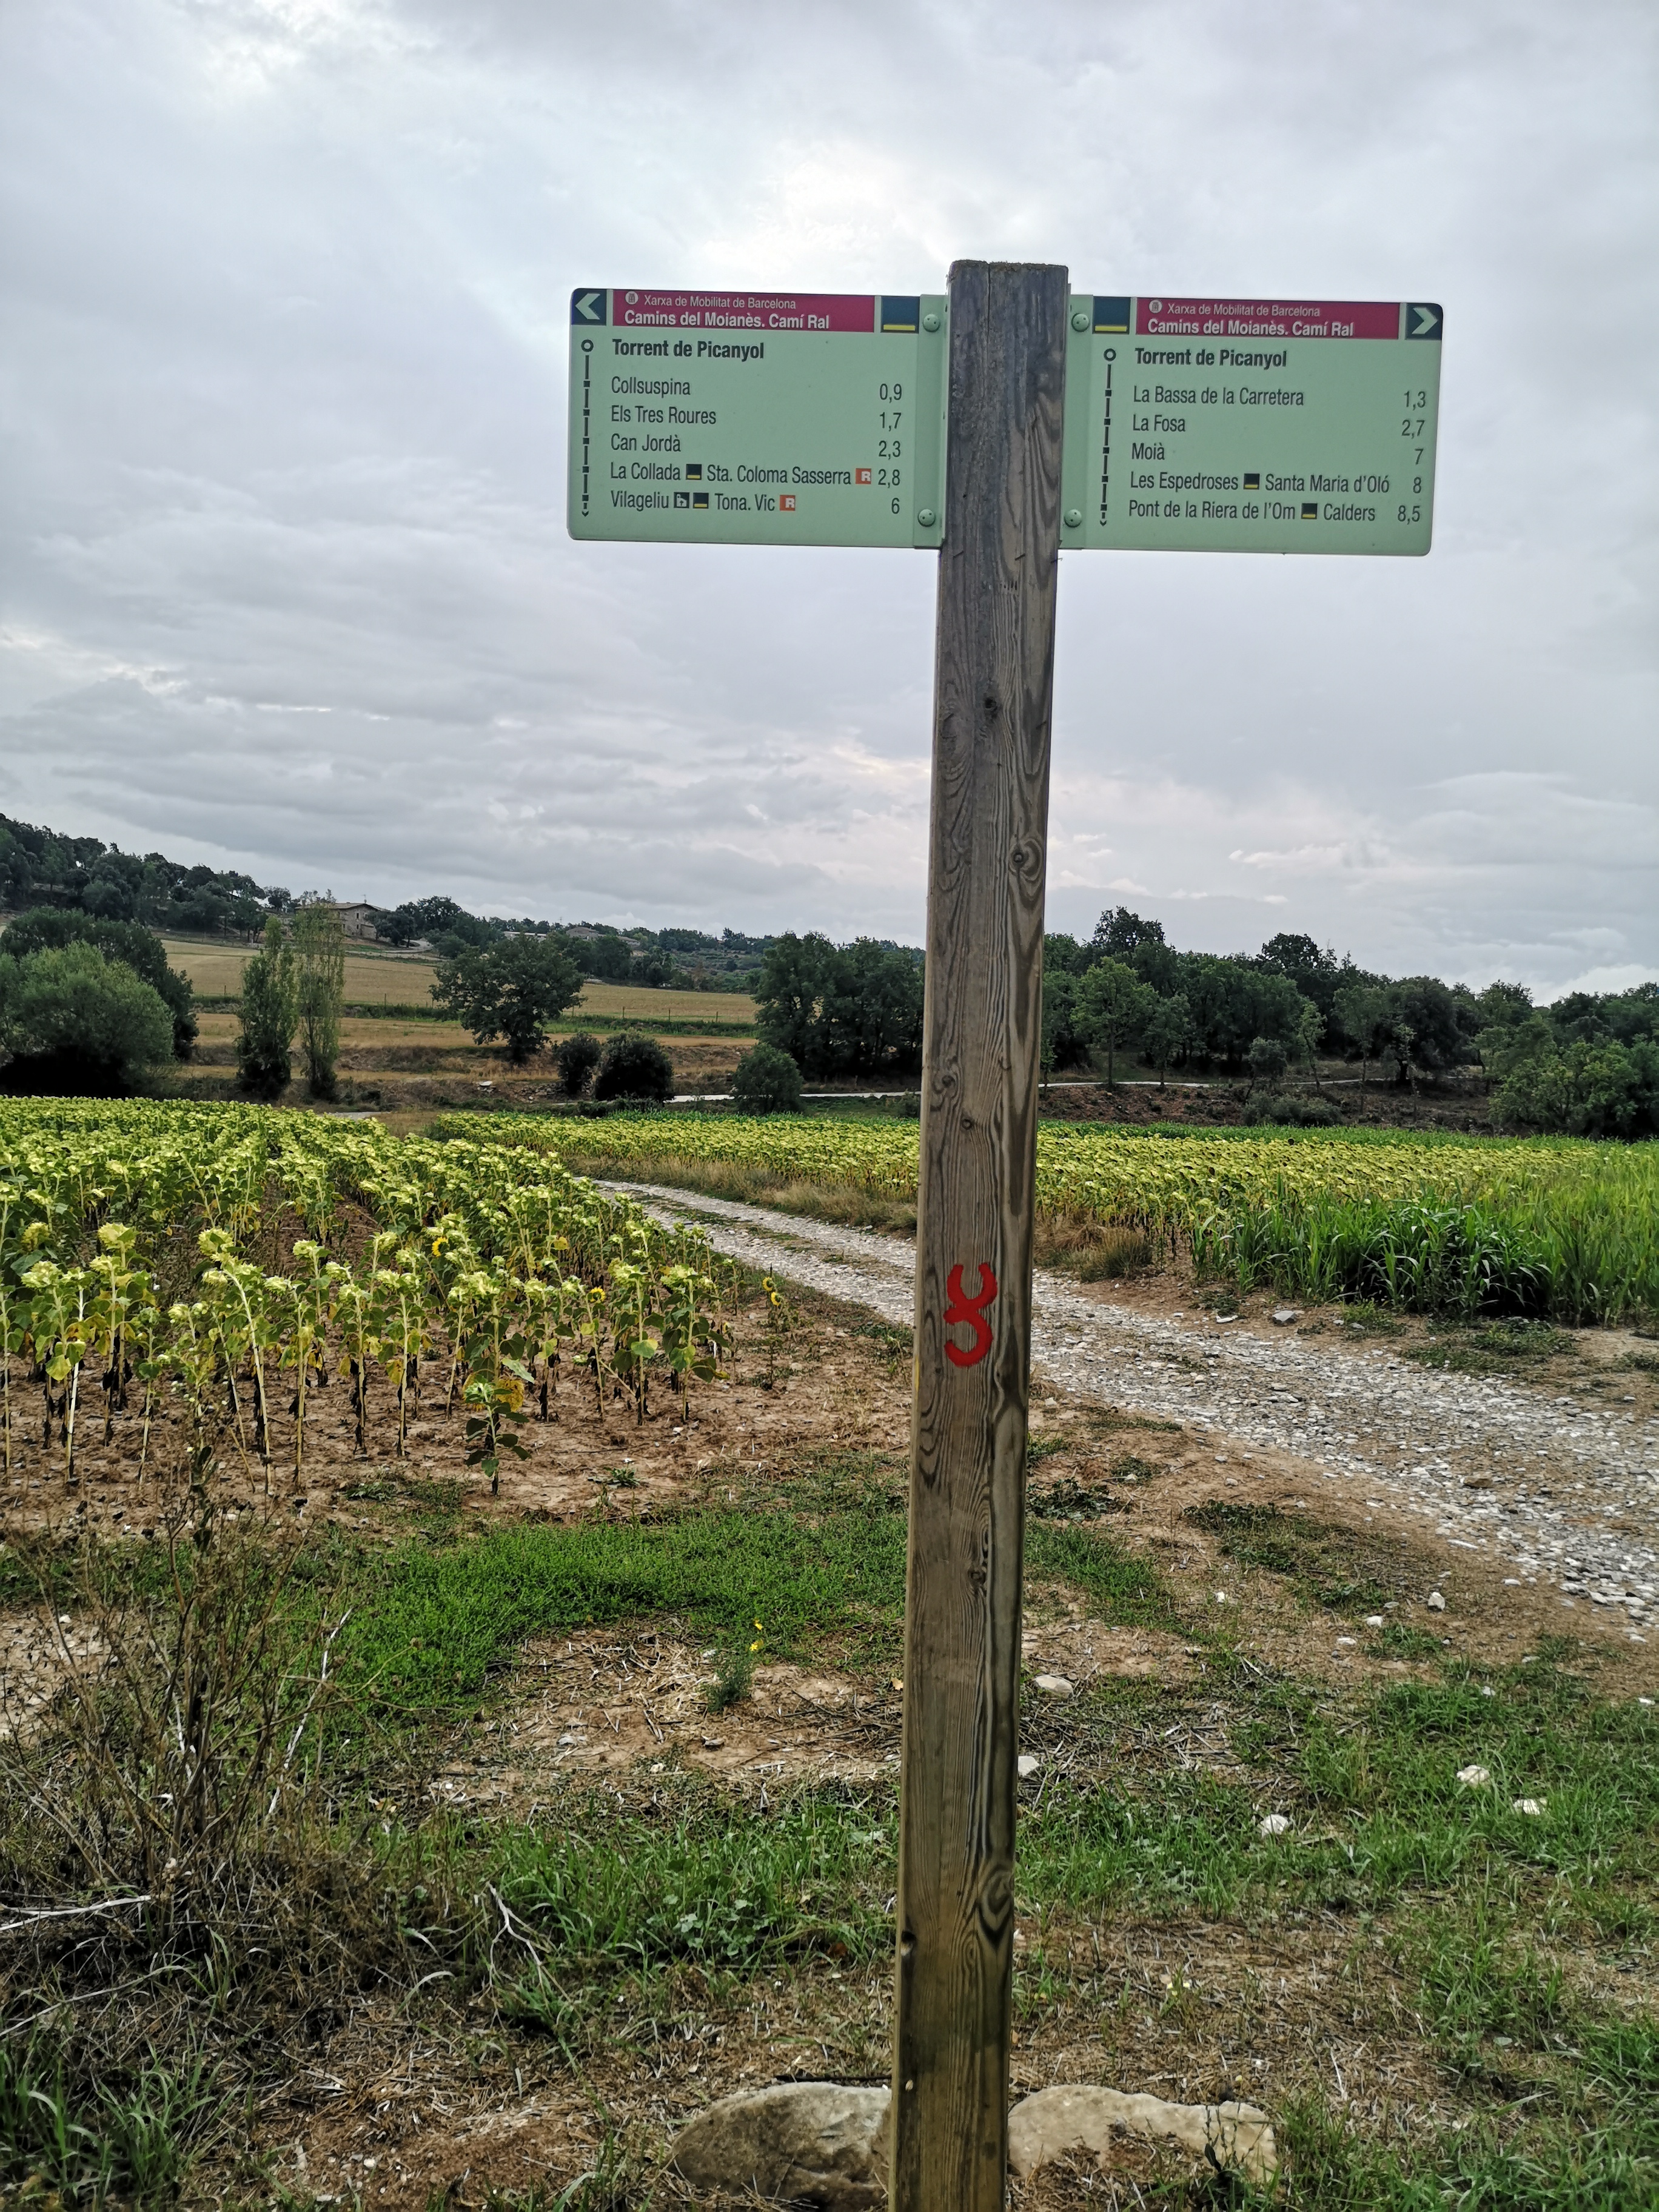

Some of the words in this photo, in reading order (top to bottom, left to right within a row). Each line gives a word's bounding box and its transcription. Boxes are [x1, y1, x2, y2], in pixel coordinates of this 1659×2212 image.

[644, 295, 672, 306] Xarxa
[675, 296, 687, 306] de
[690, 296, 730, 307] Mobilitat
[732, 298, 745, 308] de
[748, 298, 796, 309] Barcelona
[1167, 304, 1196, 314] Xarxa
[1198, 304, 1210, 315] de
[1213, 304, 1254, 316] Mobilitat
[1256, 306, 1269, 316] de
[1272, 305, 1320, 317] Barcelona
[625, 310, 676, 325] Camins
[680, 312, 700, 326] del
[705, 312, 765, 327] Moianès.
[769, 313, 805, 328] Camí
[808, 315, 830, 329] Ral
[1148, 319, 1199, 333] Camins
[1203, 320, 1224, 333] del
[1228, 321, 1289, 335] Moianès.
[1292, 321, 1328, 336] Camí
[1331, 321, 1354, 337] Ral
[612, 339, 669, 356] Torrent
[674, 340, 692, 356] de
[697, 341, 764, 362] Picanyol
[1135, 347, 1191, 365] Torrent
[1196, 349, 1215, 366] de
[1219, 350, 1287, 370] Picanyol
[611, 376, 690, 398] Collsuspina
[879, 384, 902, 403] 0,9
[1133, 386, 1150, 403] La
[1155, 386, 1196, 403] Bassa
[1201, 387, 1218, 404] de
[1223, 387, 1234, 404] la
[1239, 387, 1304, 406] Carretera
[1404, 391, 1426, 411] 1,3
[611, 404, 631, 422] Els
[635, 406, 663, 423] Tres
[669, 406, 716, 424] Roures
[879, 412, 902, 432] 1,7
[1133, 414, 1149, 431] La
[1154, 414, 1185, 432] Fosa
[1401, 420, 1425, 439] 2,7
[611, 434, 637, 451] Can
[642, 434, 681, 452] Jordà
[879, 440, 901, 460] 2,3
[1131, 443, 1165, 460] Moià
[1415, 448, 1424, 465] 7
[610, 462, 626, 479] La
[631, 463, 680, 480] Collada
[707, 464, 732, 481] Sta.
[737, 465, 788, 484] Coloma
[792, 466, 851, 484] Sasserra
[861, 471, 871, 481] R
[878, 469, 900, 489] 2,8
[1131, 471, 1154, 489] Les
[1159, 472, 1238, 492] Espedroses
[1265, 474, 1304, 491] Santa
[1310, 475, 1349, 492] Maria
[1353, 475, 1390, 493] d'Oló
[1413, 477, 1421, 494] 8
[611, 491, 669, 512] Vilageliu
[715, 493, 751, 511] Tona.
[754, 494, 775, 511] Vic
[785, 498, 795, 508] R
[891, 497, 900, 514] 6
[1129, 500, 1159, 517] Pont
[1164, 501, 1180, 518] de
[1185, 501, 1197, 518] la
[1202, 501, 1237, 518] Riera
[1242, 502, 1259, 519] de
[1264, 502, 1295, 520] l'Om
[1324, 503, 1375, 521] Calders
[1398, 505, 1420, 525] 8,5
